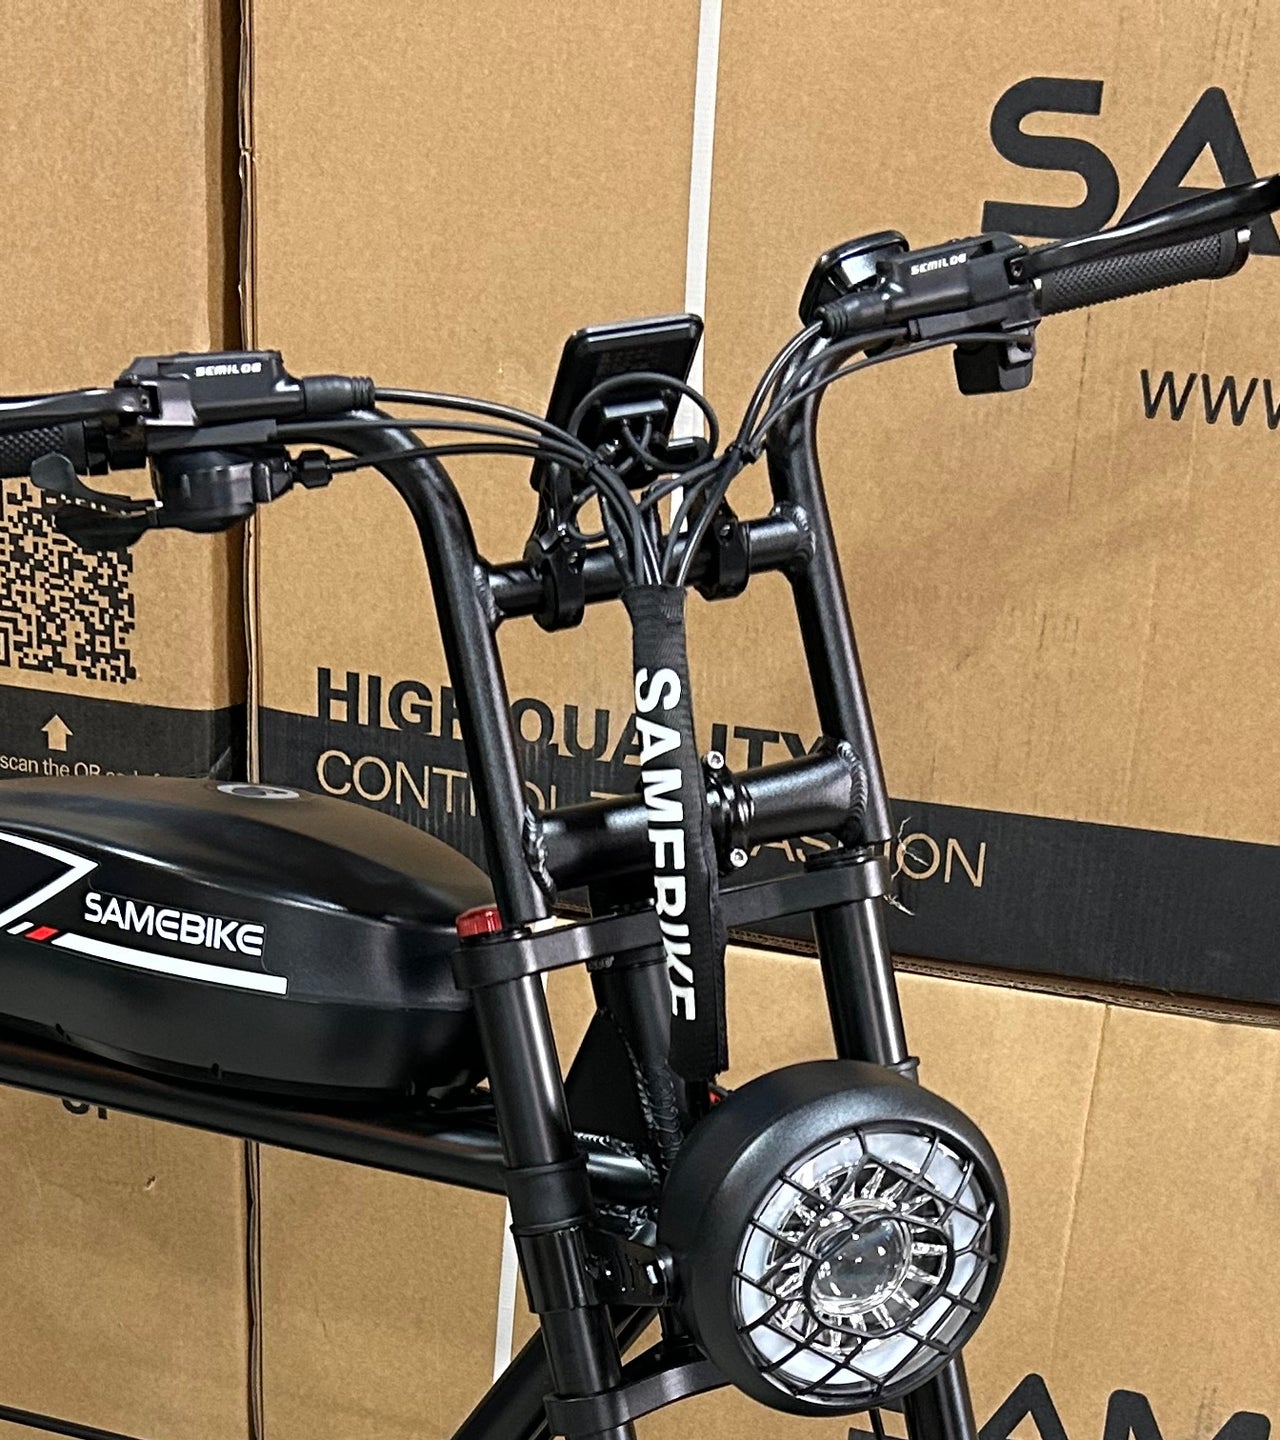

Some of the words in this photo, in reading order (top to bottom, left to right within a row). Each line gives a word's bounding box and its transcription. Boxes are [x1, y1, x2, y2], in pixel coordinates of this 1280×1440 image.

[0, 755, 38, 774] scan
[42, 757, 69, 777] the
[84, 892, 265, 956] SAMEBIKE
